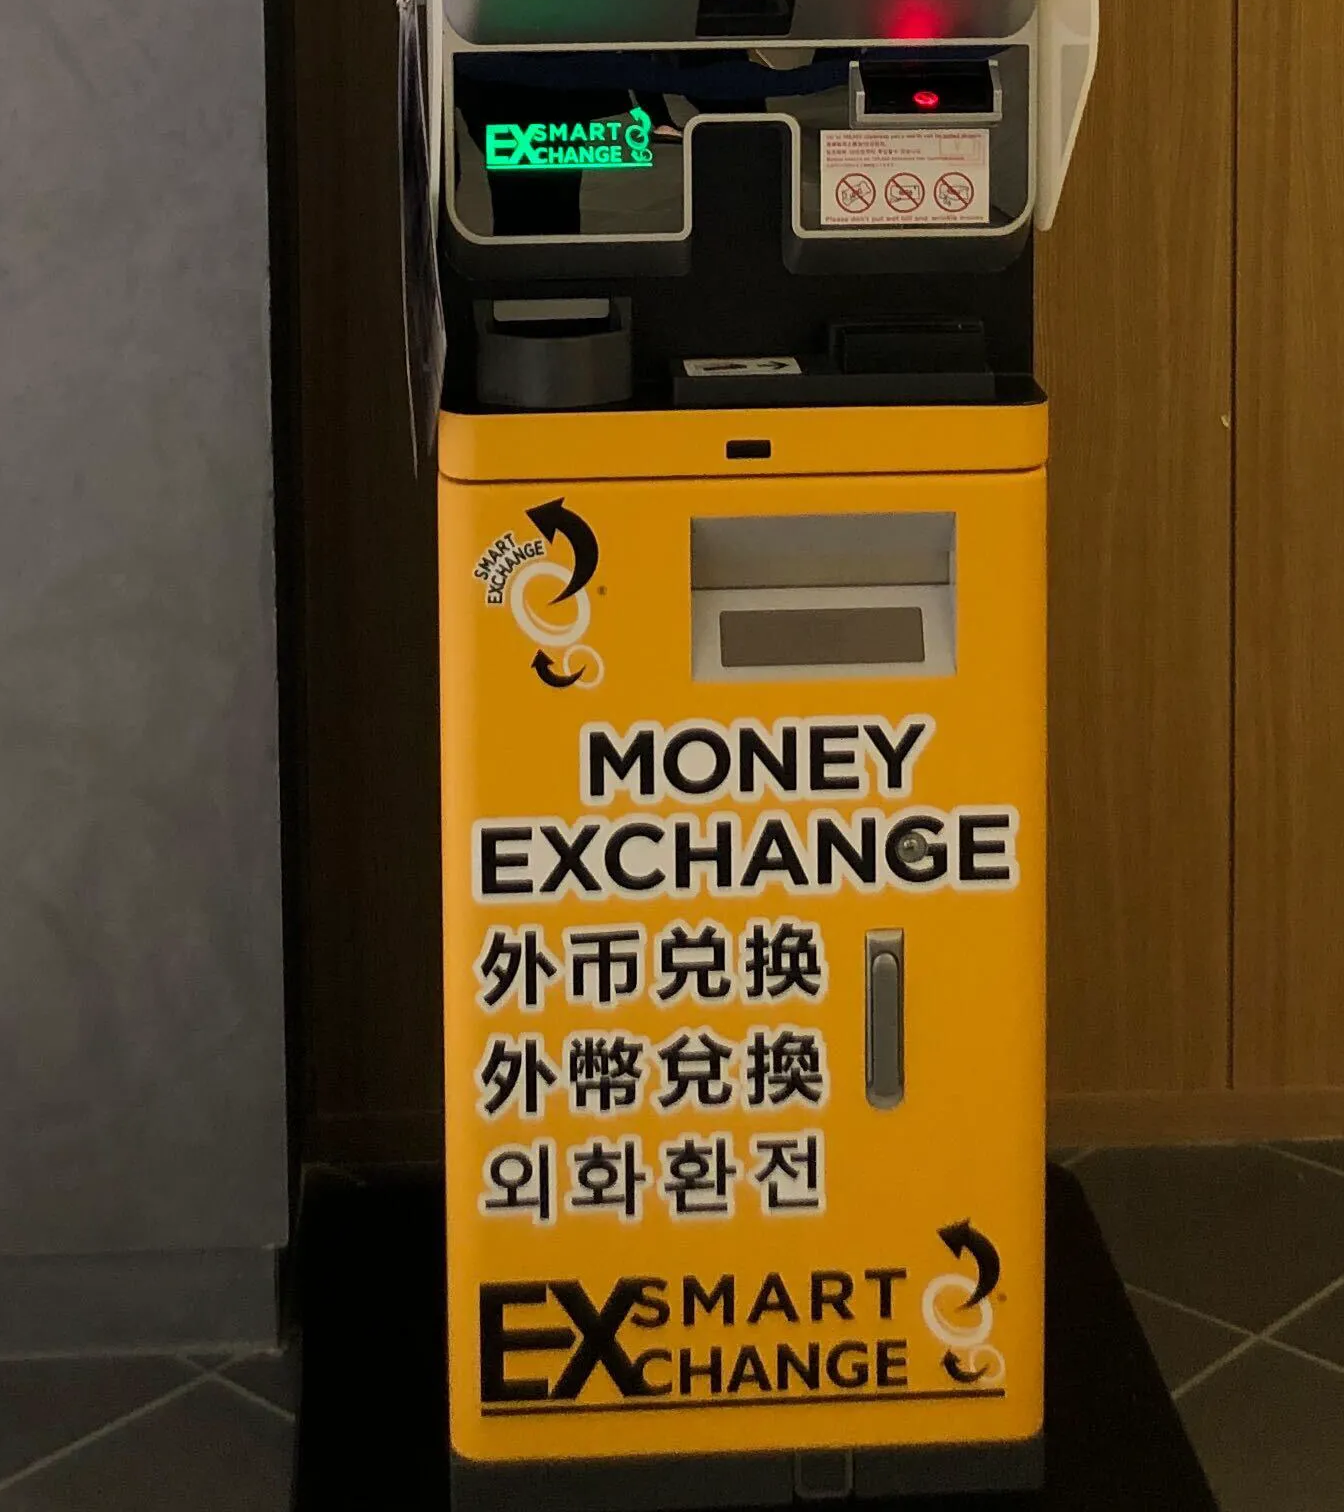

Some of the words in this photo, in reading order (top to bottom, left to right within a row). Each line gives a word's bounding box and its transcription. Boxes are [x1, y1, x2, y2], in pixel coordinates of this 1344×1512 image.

[534, 122, 622, 142] SMART
[473, 532, 516, 581] SMART
[487, 540, 545, 604] EXCHANGE
[588, 722, 927, 797] MONEY
[480, 813, 1011, 895] EXCHANGE
[479, 921, 822, 1007] 外币兑换
[480, 1030, 823, 1115] 外幣兌換
[484, 1133, 821, 1222] 외화환전
[632, 1267, 908, 1329] SMART
[479, 1276, 646, 1404] EX
